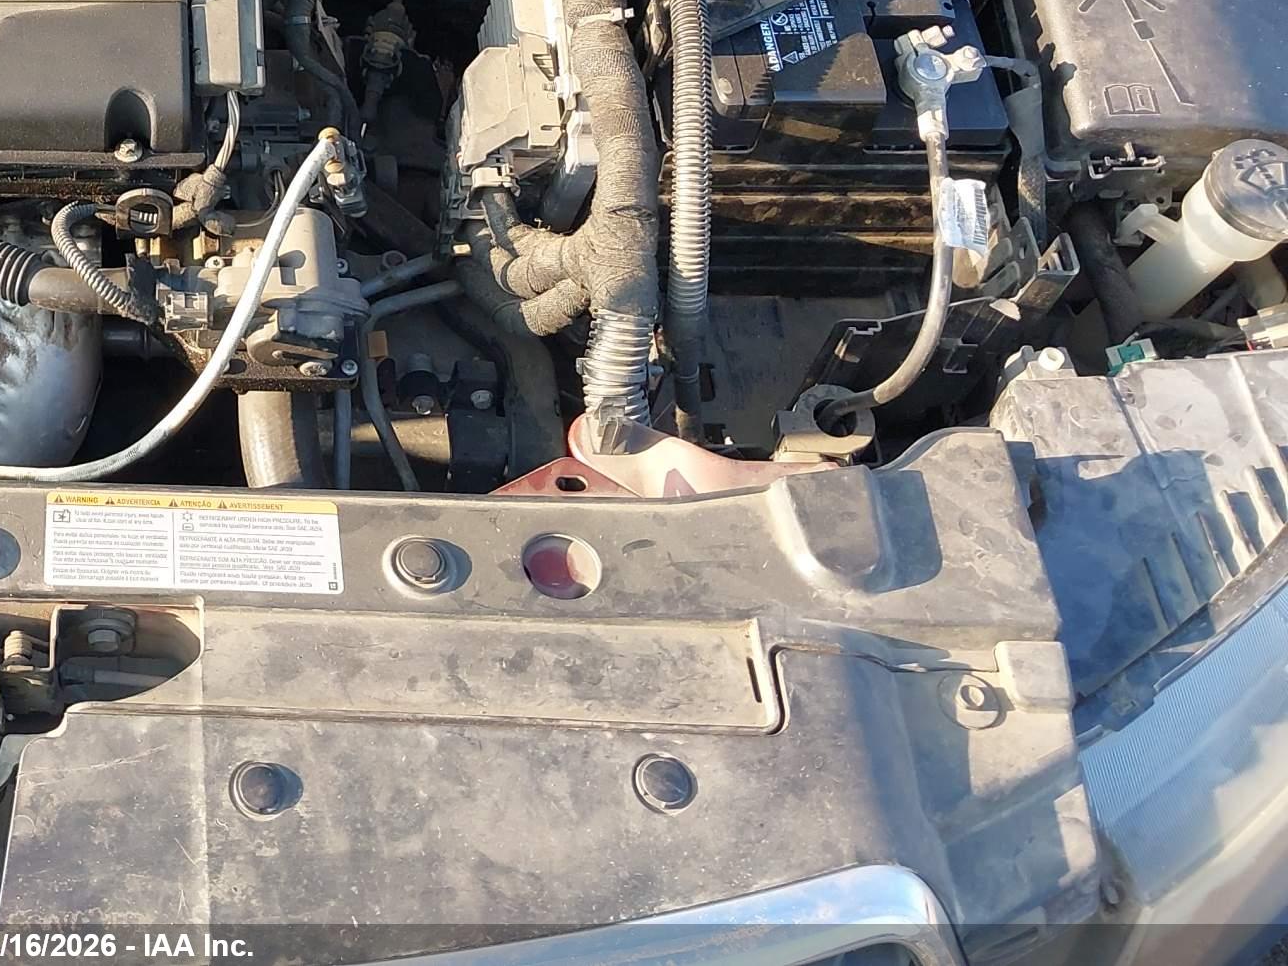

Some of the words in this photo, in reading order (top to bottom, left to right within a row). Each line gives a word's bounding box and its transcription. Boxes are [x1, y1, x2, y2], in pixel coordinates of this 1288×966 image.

[117, 498, 160, 506] ADVERTENCIA
[180, 499, 212, 509] ATENÇÃO
[229, 502, 283, 511] AVERTISSEMENT
